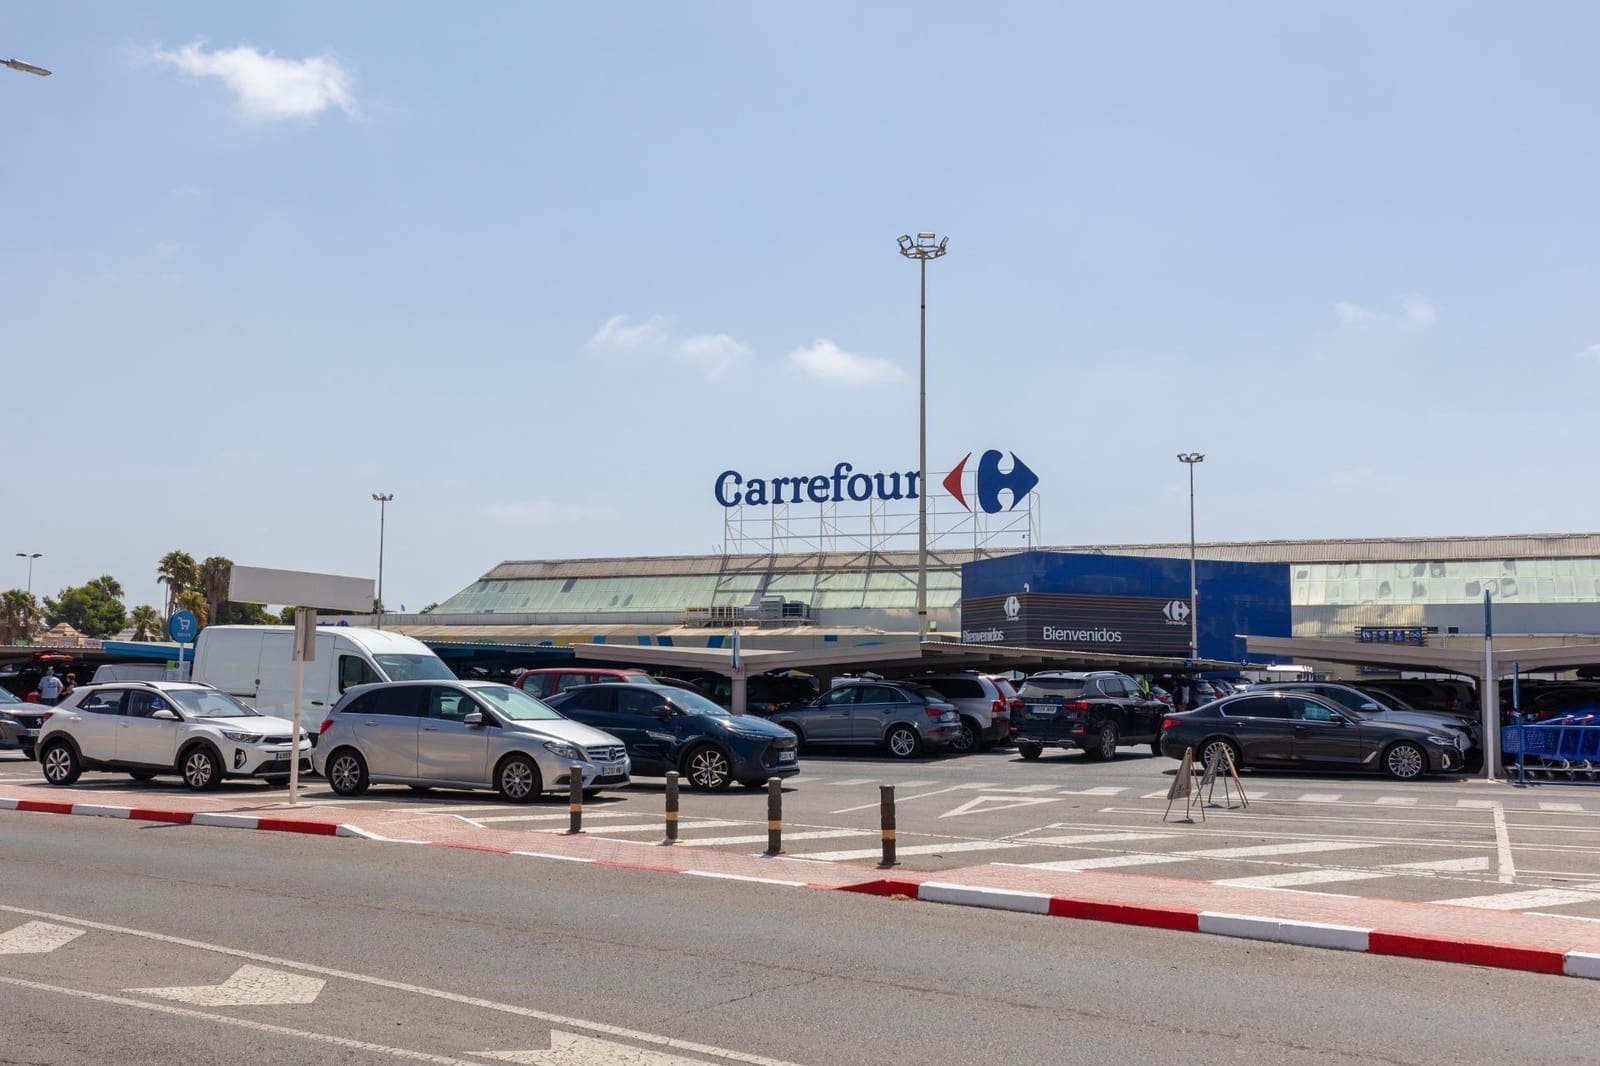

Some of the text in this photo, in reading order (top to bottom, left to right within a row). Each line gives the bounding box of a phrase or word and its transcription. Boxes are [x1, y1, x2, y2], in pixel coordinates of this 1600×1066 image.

[714, 463, 920, 507] Carrefour
[963, 627, 1004, 642] Bienvenidos
[1043, 626, 1121, 642] Bienvenidos
